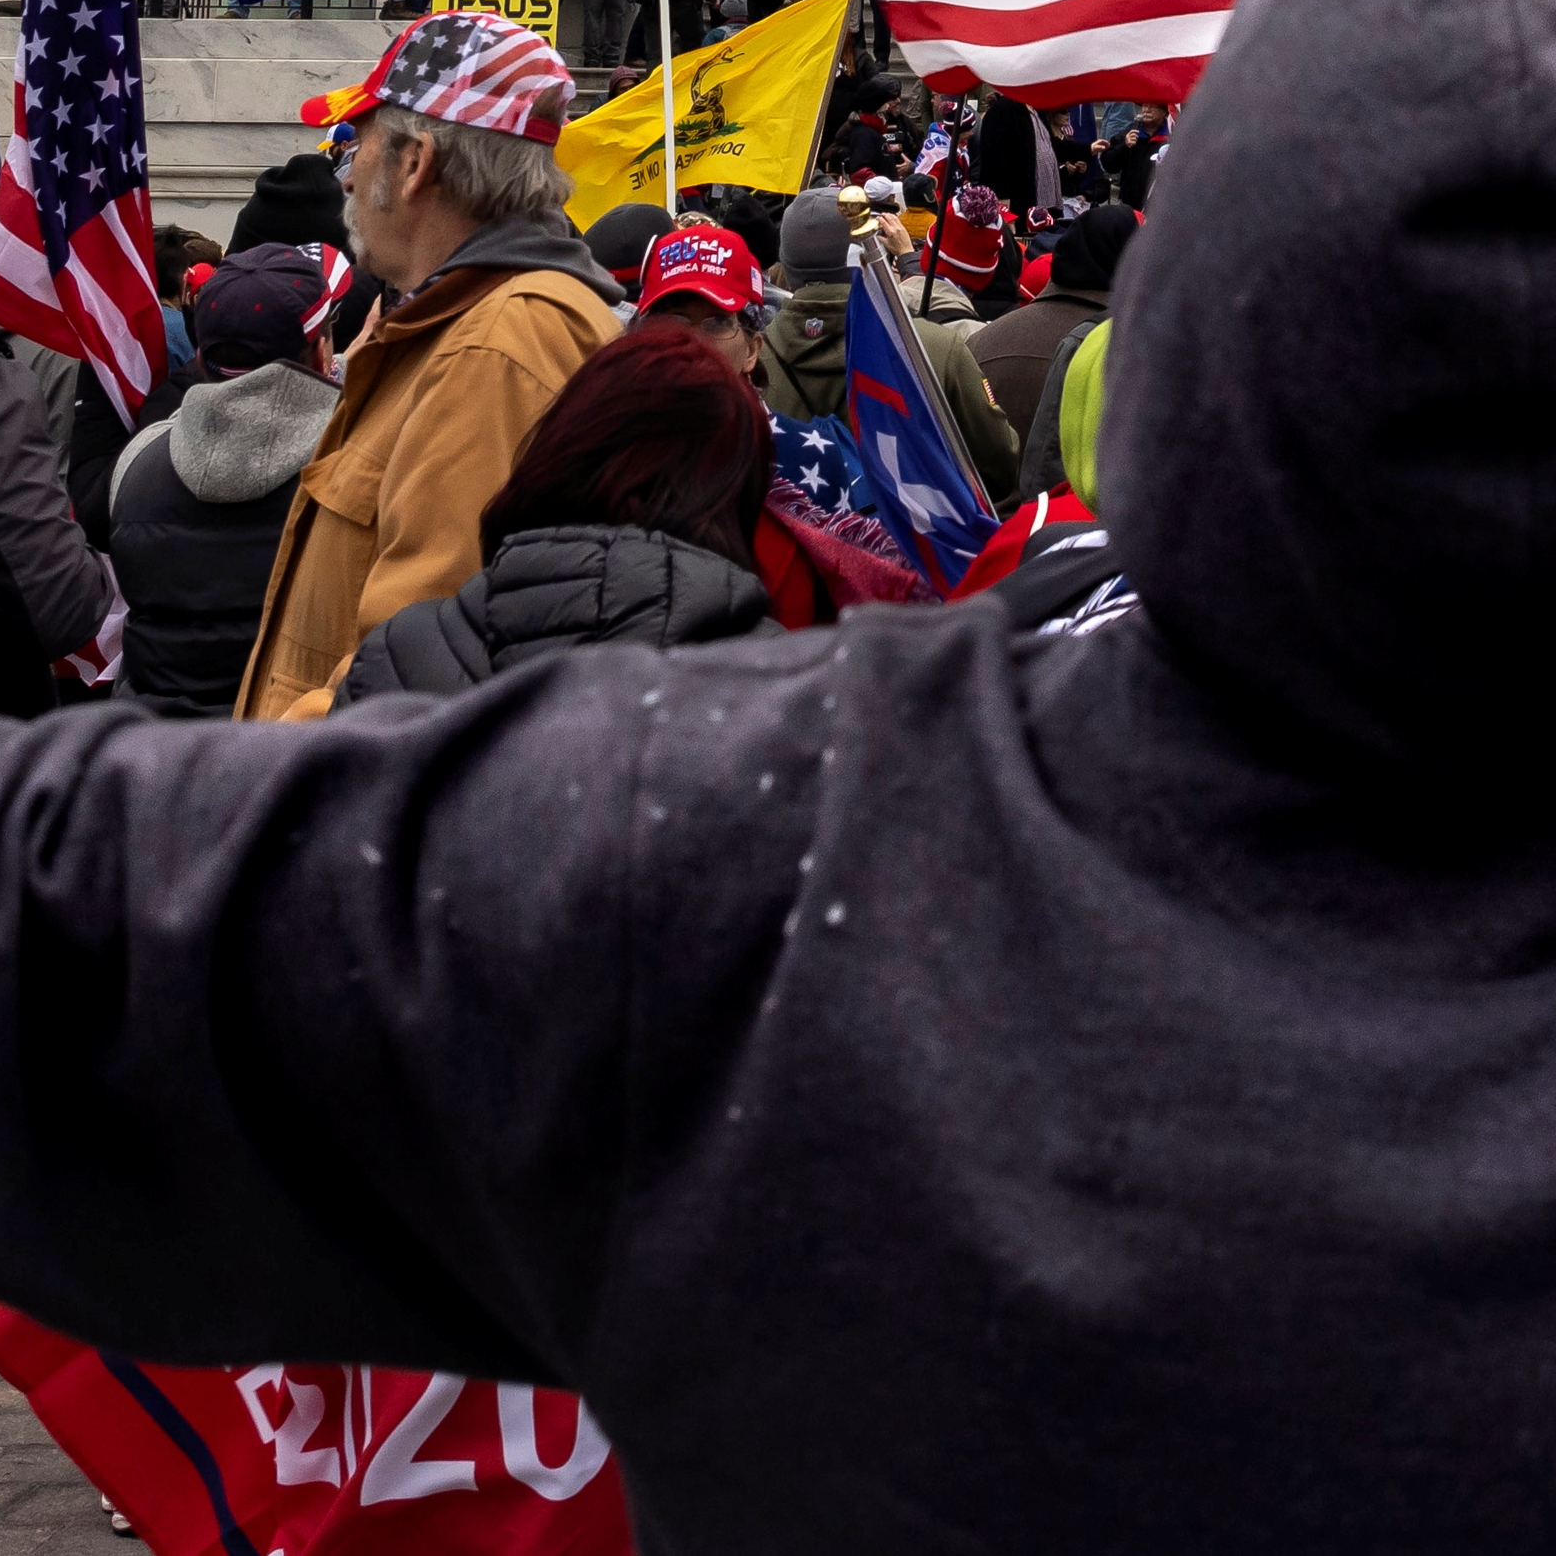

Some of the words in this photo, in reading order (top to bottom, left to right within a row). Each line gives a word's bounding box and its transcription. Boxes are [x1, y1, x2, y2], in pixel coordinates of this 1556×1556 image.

[658, 235, 733, 271] TRUMP
[661, 263, 699, 281] AMERICA
[701, 263, 728, 276] FIRST
